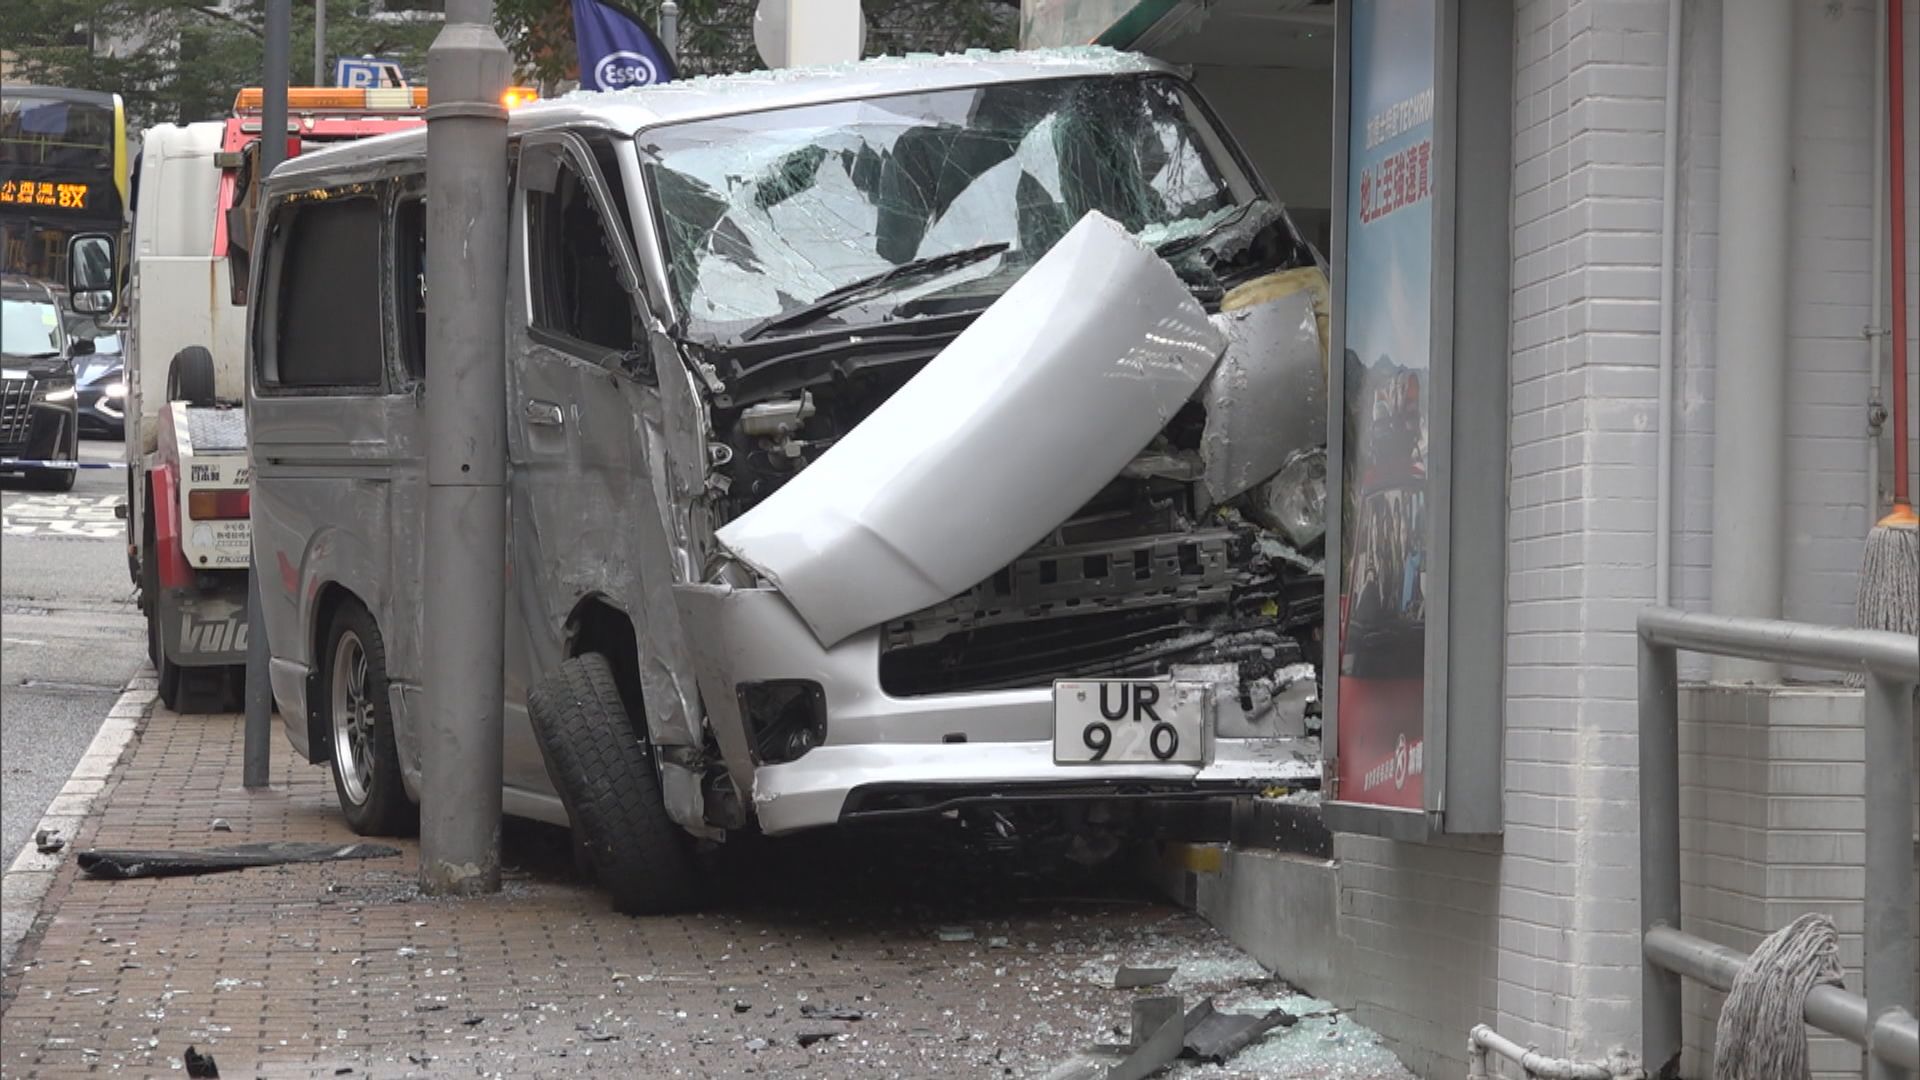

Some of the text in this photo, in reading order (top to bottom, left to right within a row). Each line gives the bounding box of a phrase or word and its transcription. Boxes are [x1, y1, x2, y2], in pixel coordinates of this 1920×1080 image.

[604, 63, 648, 84] Esso
[1359, 139, 1434, 224] 地上至強遠實
[59, 191, 84, 208] 8X
[1100, 683, 1161, 721] UR
